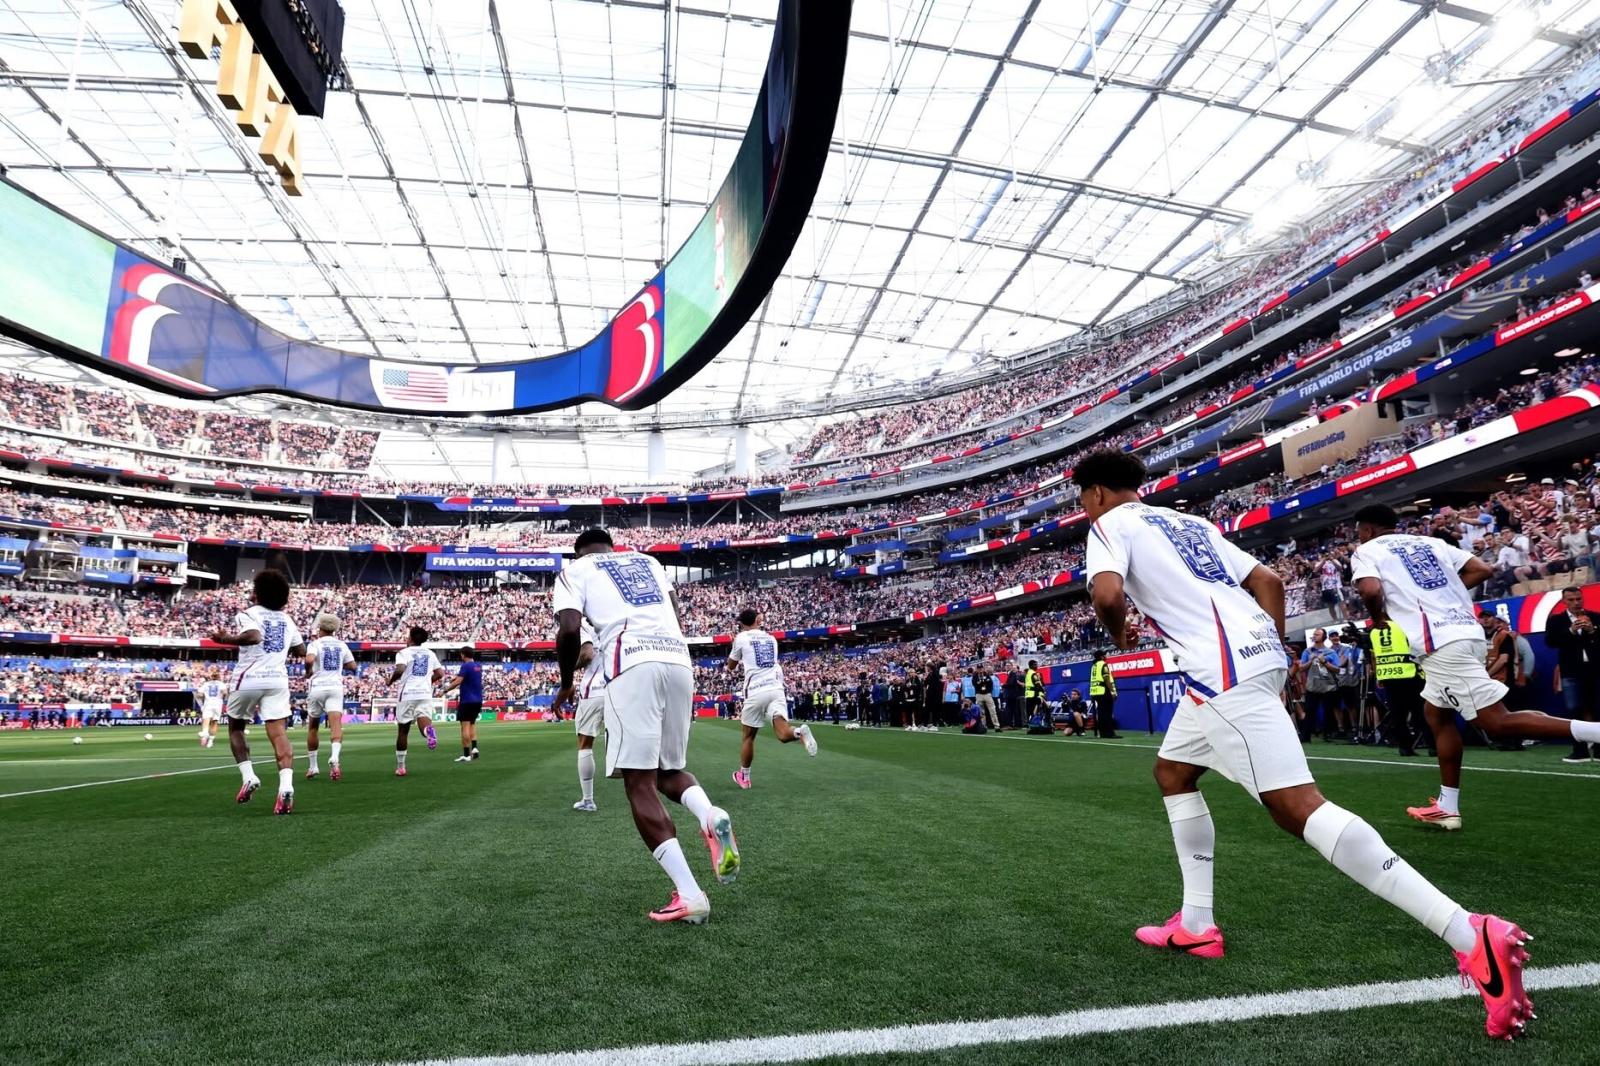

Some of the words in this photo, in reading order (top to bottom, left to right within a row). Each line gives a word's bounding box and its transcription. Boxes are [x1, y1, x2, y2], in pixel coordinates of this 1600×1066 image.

[178, 0, 302, 196] FIFA
[1300, 385, 1319, 398] FIFA
[1319, 365, 1352, 388] WORLD
[1353, 355, 1373, 372] CUP
[1374, 336, 1412, 361] 2026
[1149, 439, 1195, 466] ANGELES
[1297, 430, 1345, 457] #FIFAWorldCup
[432, 557, 456, 566] FIFA
[457, 558, 496, 567] WORLD
[496, 558, 519, 567] CUP
[519, 558, 555, 567] 2026
[624, 645, 651, 657] Men's
[1238, 640, 1272, 660] Men's
[1376, 655, 1405, 664] ECURITY
[1151, 679, 1182, 704] FIFA
[177, 717, 202, 726] QATA
